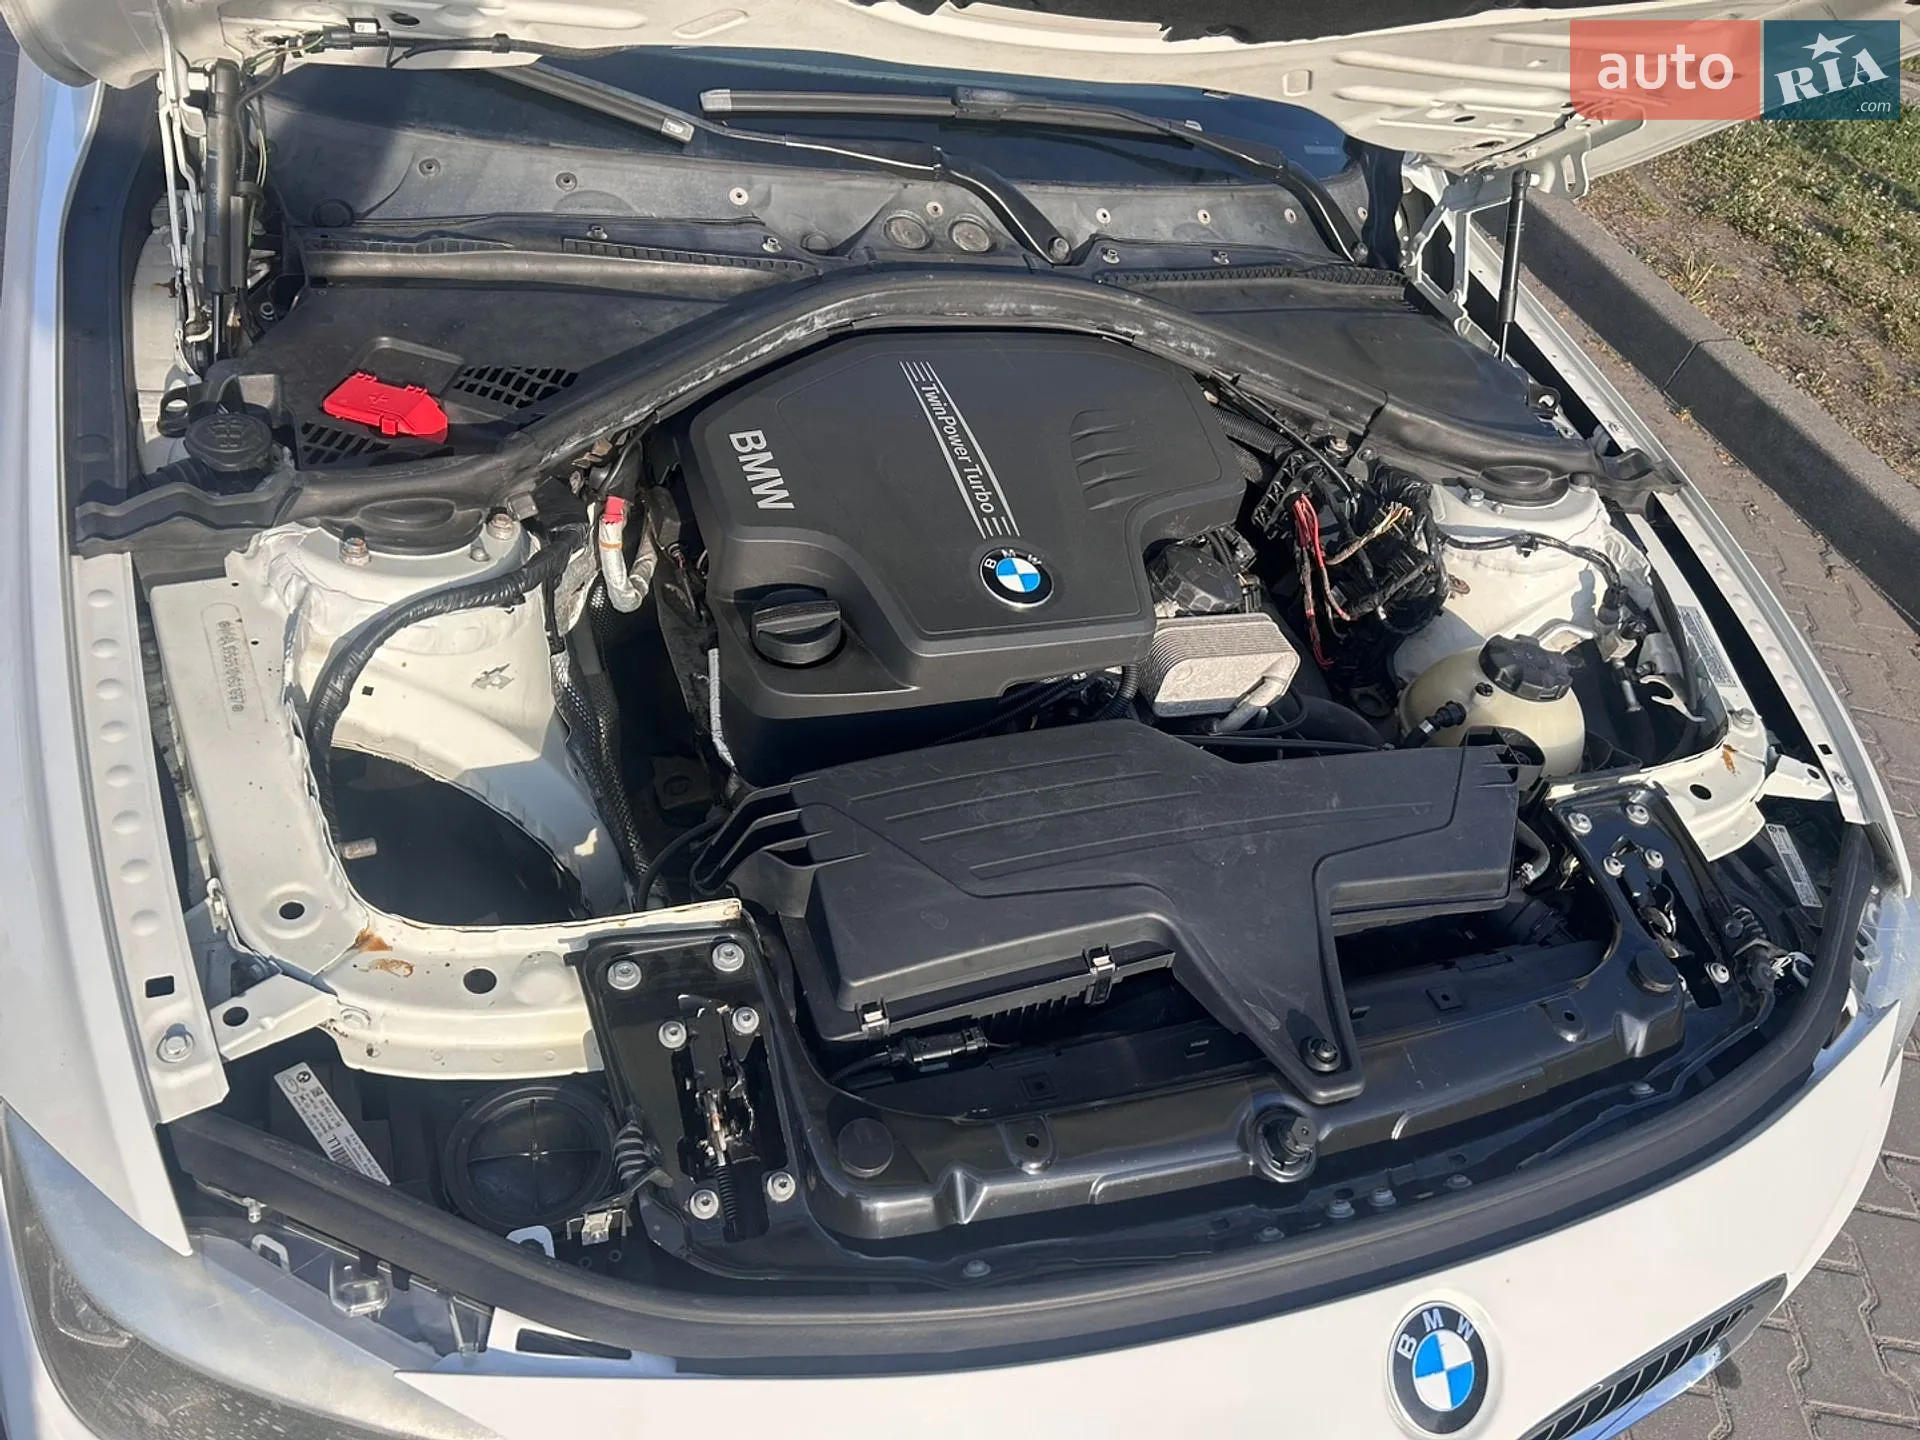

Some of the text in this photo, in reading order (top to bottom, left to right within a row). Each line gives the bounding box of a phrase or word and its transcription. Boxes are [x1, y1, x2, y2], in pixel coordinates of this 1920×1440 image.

[729, 429, 795, 509] BMW
[921, 383, 995, 514] TwinPower Turbo
[984, 549, 1042, 569] BMW
[1397, 1308, 1475, 1360] BMW
